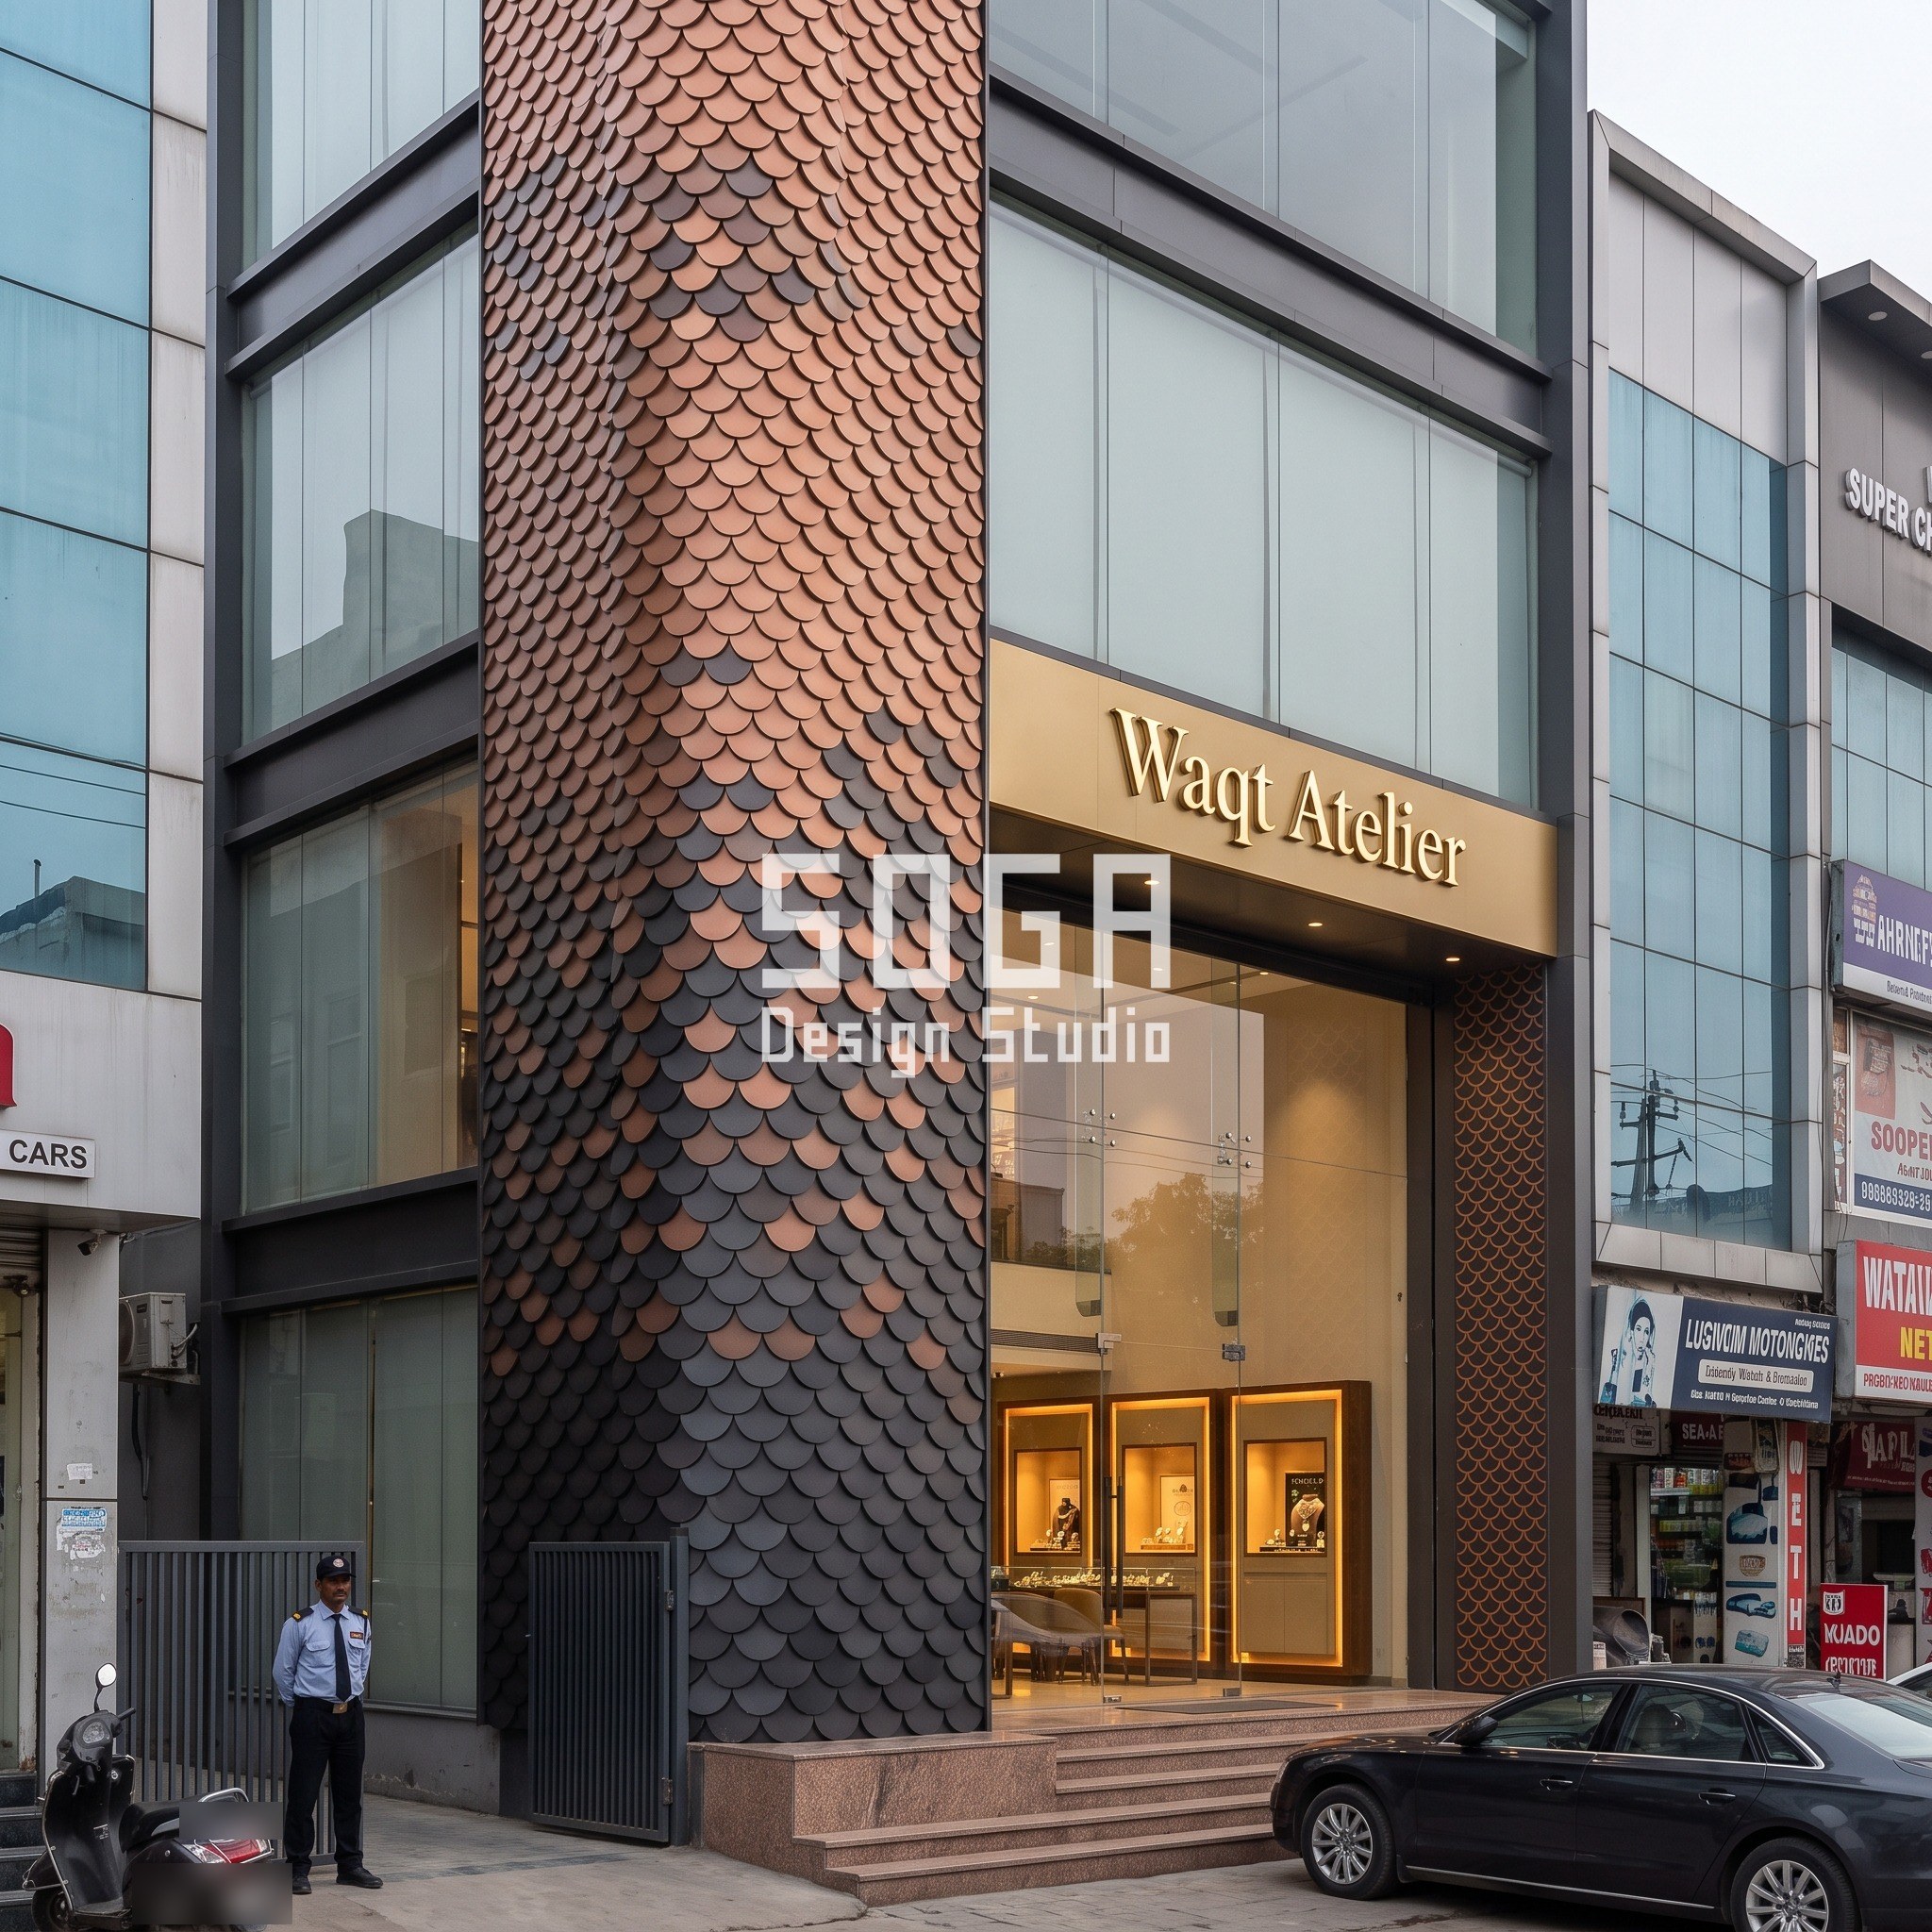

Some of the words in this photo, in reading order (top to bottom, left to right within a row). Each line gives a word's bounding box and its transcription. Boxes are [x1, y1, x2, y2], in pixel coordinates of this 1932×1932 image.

[1845, 467, 1909, 539] SUPER
[1109, 708, 1275, 847] Waqt
[1284, 770, 1467, 888] Atelier
[8, 1139, 87, 1170] CARS
